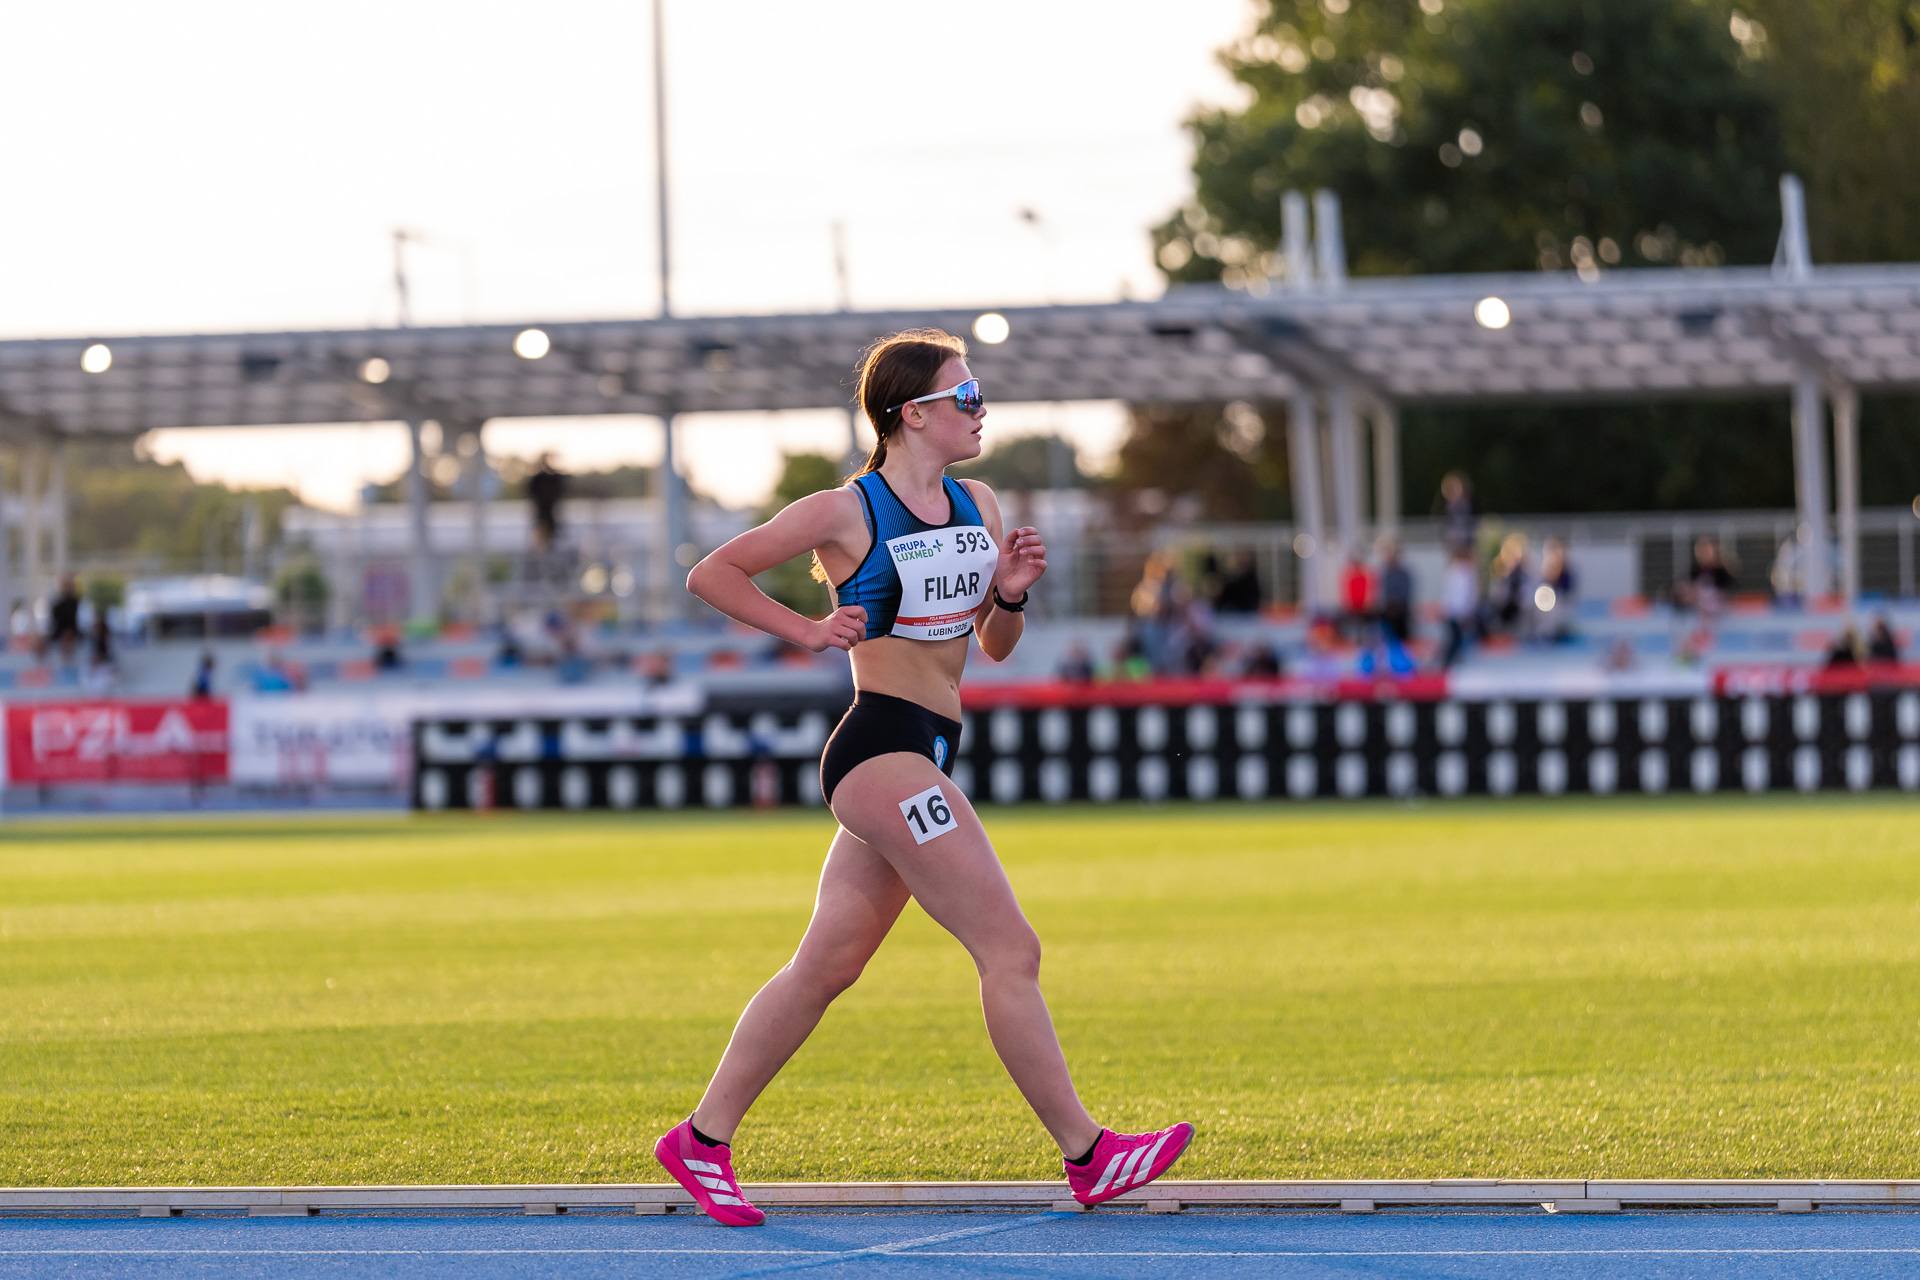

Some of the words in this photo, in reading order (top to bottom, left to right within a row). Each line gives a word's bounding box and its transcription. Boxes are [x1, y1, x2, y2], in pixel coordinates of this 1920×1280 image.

[892, 540, 927, 553] GRUPA
[955, 531, 990, 554] 593
[895, 548, 934, 562] LUXMED
[924, 571, 980, 602] FILAR
[927, 626, 953, 637] LUBIN
[906, 794, 951, 835] 16
